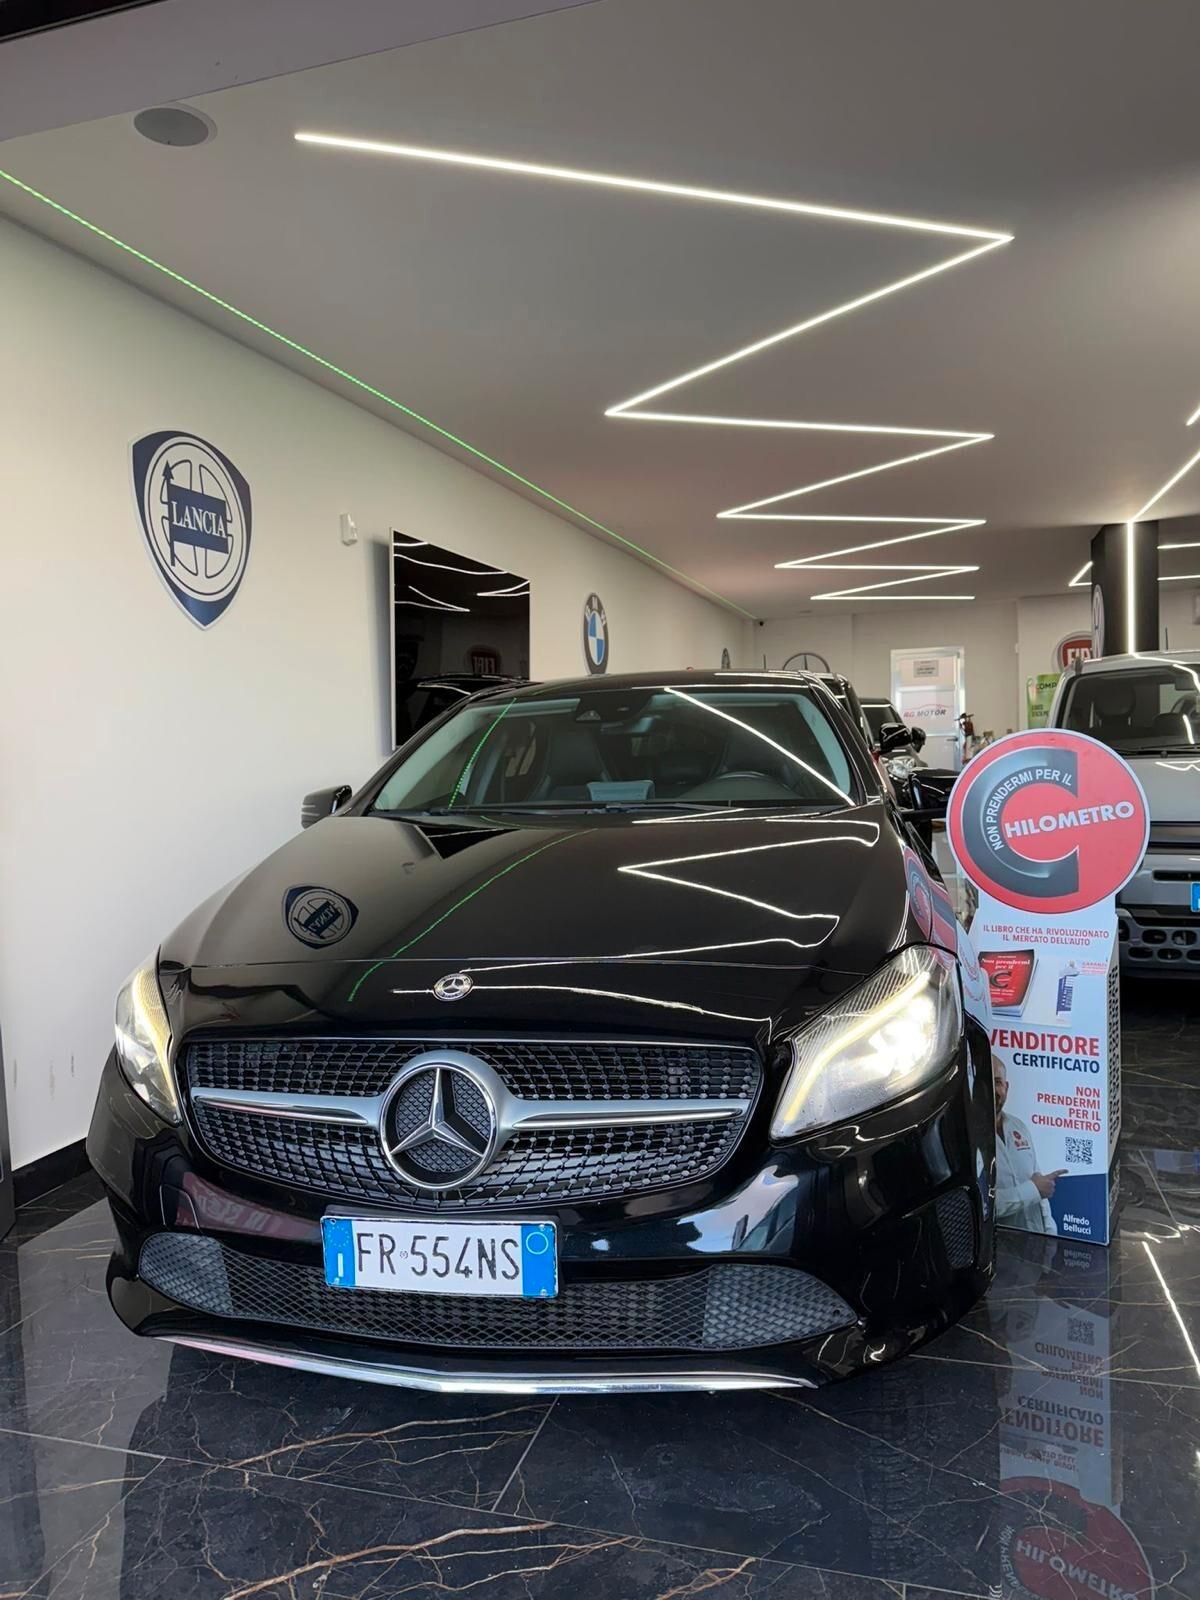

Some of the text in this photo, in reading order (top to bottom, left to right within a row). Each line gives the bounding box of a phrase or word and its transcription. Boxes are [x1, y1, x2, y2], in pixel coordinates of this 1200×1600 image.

[171, 500, 228, 541] LANCIA
[1066, 647, 1093, 665] FIA
[917, 709, 946, 717] MOTOR
[986, 768, 1073, 851] NON PRENDERMI PER IL
[992, 925, 1013, 933] LIBRO
[1015, 926, 1031, 934] CHE
[1032, 927, 1043, 935] HA
[1046, 927, 1109, 938] RIVOLUZIONATO
[1002, 934, 1009, 942] IL
[1013, 935, 1049, 944] MERCATO
[1013, 1052, 1100, 1073] CERTIFICATO
[1075, 1086, 1100, 1098] NON
[1037, 1093, 1100, 1109] PRENDERMI
[1069, 1108, 1101, 1121] PER IL
[1031, 1114, 1101, 1132] CHILOMETRO
[1063, 1214, 1090, 1225] Alfredo
[1063, 1223, 1092, 1235] Bellucci
